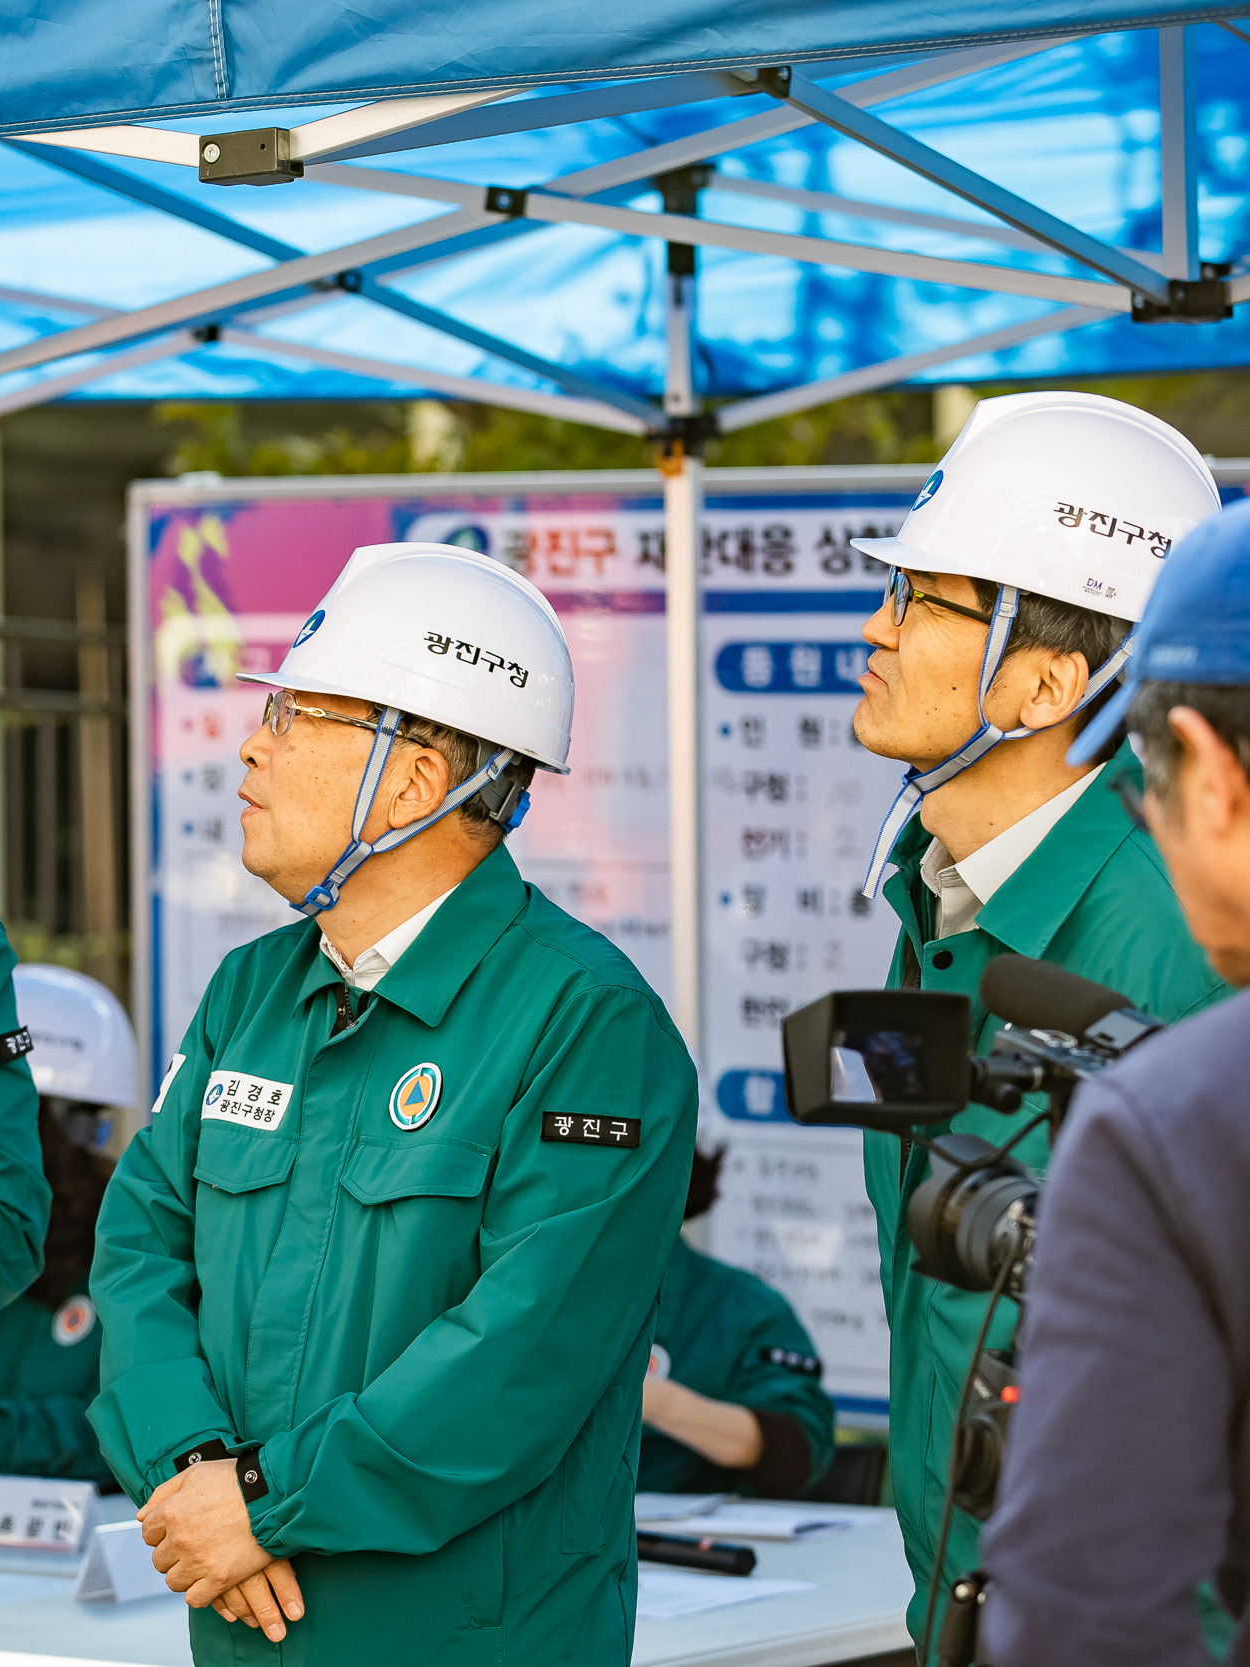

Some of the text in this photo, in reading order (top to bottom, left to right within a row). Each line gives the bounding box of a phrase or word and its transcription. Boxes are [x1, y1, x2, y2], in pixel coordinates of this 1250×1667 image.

[1053, 501, 1172, 560] 광진구청
[423, 631, 529, 689] 광진구청
[219, 1099, 276, 1123] 광진구청장
[554, 1116, 628, 1141] 광진구
